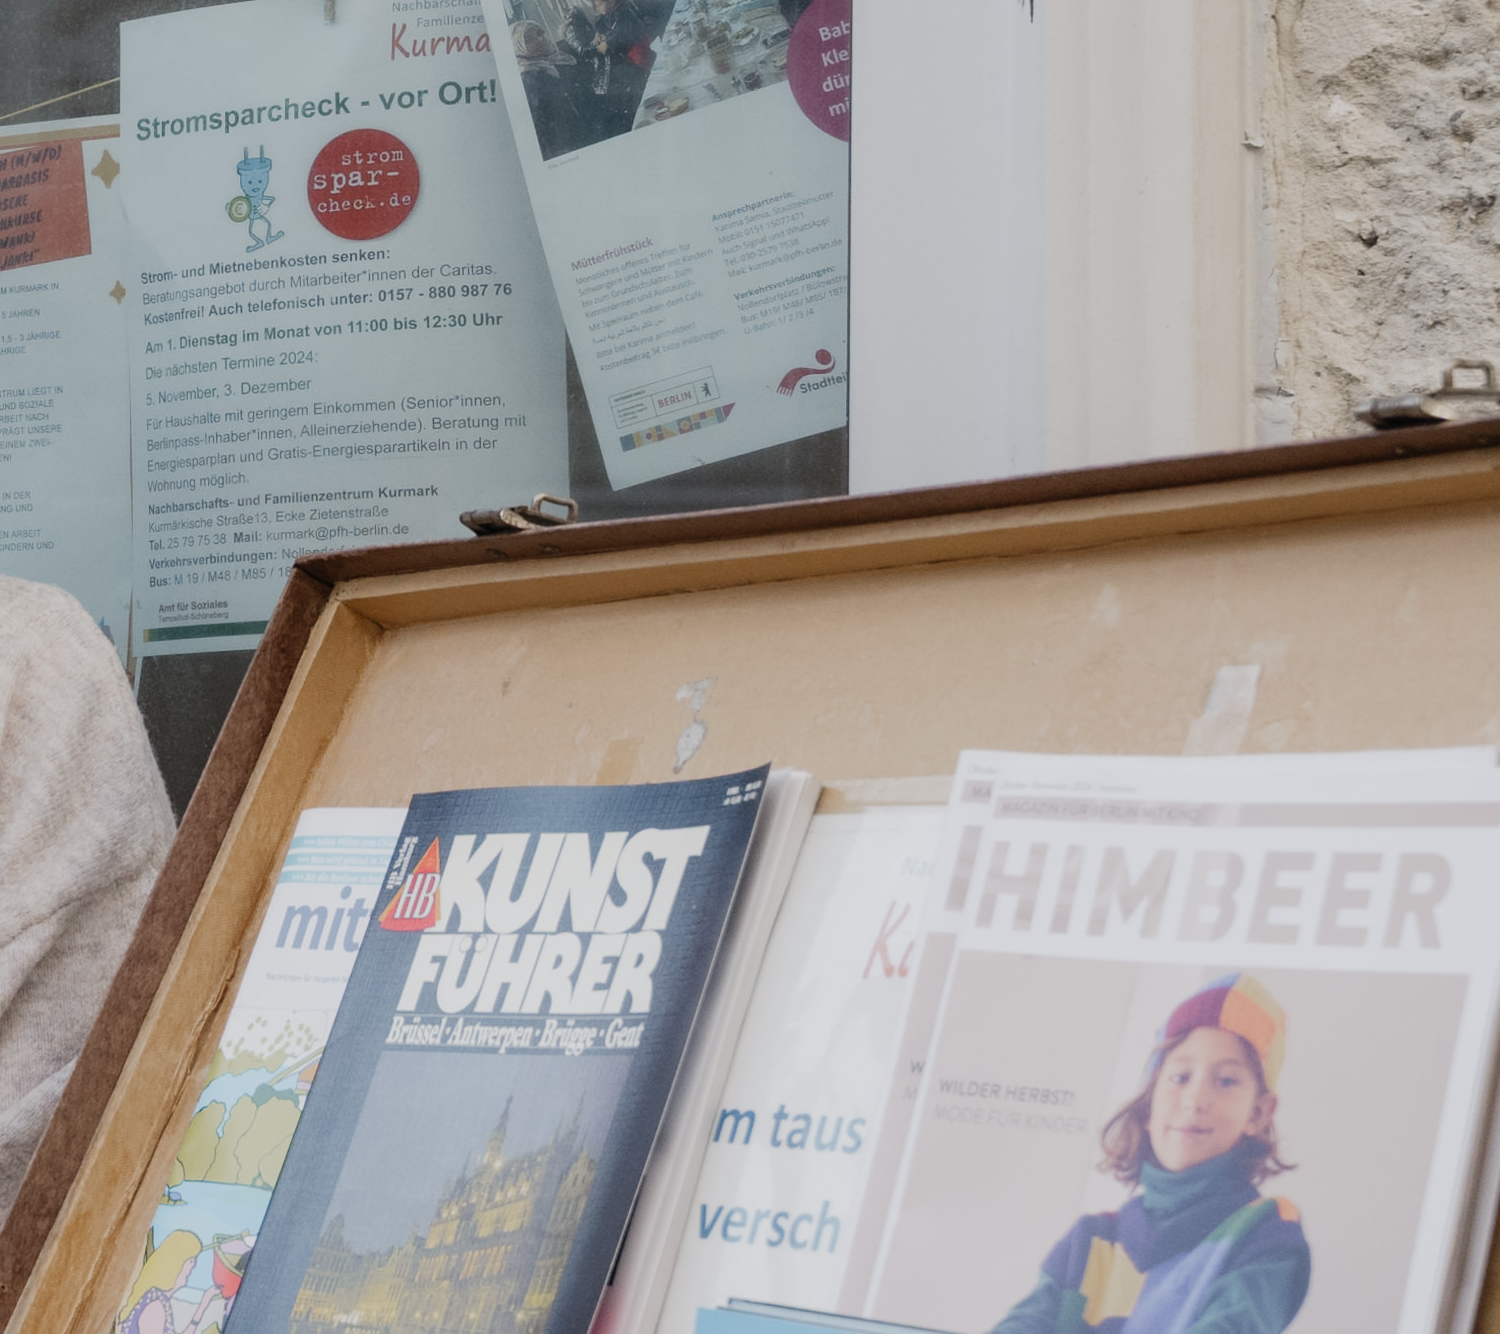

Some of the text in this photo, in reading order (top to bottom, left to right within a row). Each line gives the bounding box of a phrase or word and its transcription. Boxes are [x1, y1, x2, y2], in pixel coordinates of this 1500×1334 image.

[136, 79, 497, 141] Stromsparcheck vor Ort!
[341, 150, 404, 165] strom
[313, 169, 399, 194] spar-
[317, 193, 411, 212] check.de
[141, 249, 390, 285] Strom- und Mietnebenkosten senken:
[143, 281, 245, 305] Beratungsangebot
[249, 277, 285, 292] durch
[411, 266, 434, 279] der
[440, 263, 497, 277] Caritas.
[144, 283, 512, 326] Kostenfrei! Auch telefonisch unter: 0157 880 987 76
[145, 312, 503, 354] Am 1. Dienstag im Monat von 11:00 bis 12:30 Uhr
[145, 350, 318, 380] Die nächsten Termine 2024:
[158, 386, 220, 404] November,
[241, 378, 312, 395] Dezember
[657, 391, 692, 409] BERLIN
[148, 485, 439, 515] Nachbarschafts- und Familienzentrum Kurmark
[393, 873, 441, 920] HB
[425, 825, 711, 934] KUNST
[974, 840, 1453, 950] HIMBEER
[275, 885, 372, 953] mit
[396, 930, 662, 1014] FÜHRER
[939, 1079, 999, 1100] WILDER
[699, 1200, 841, 1254] versch
